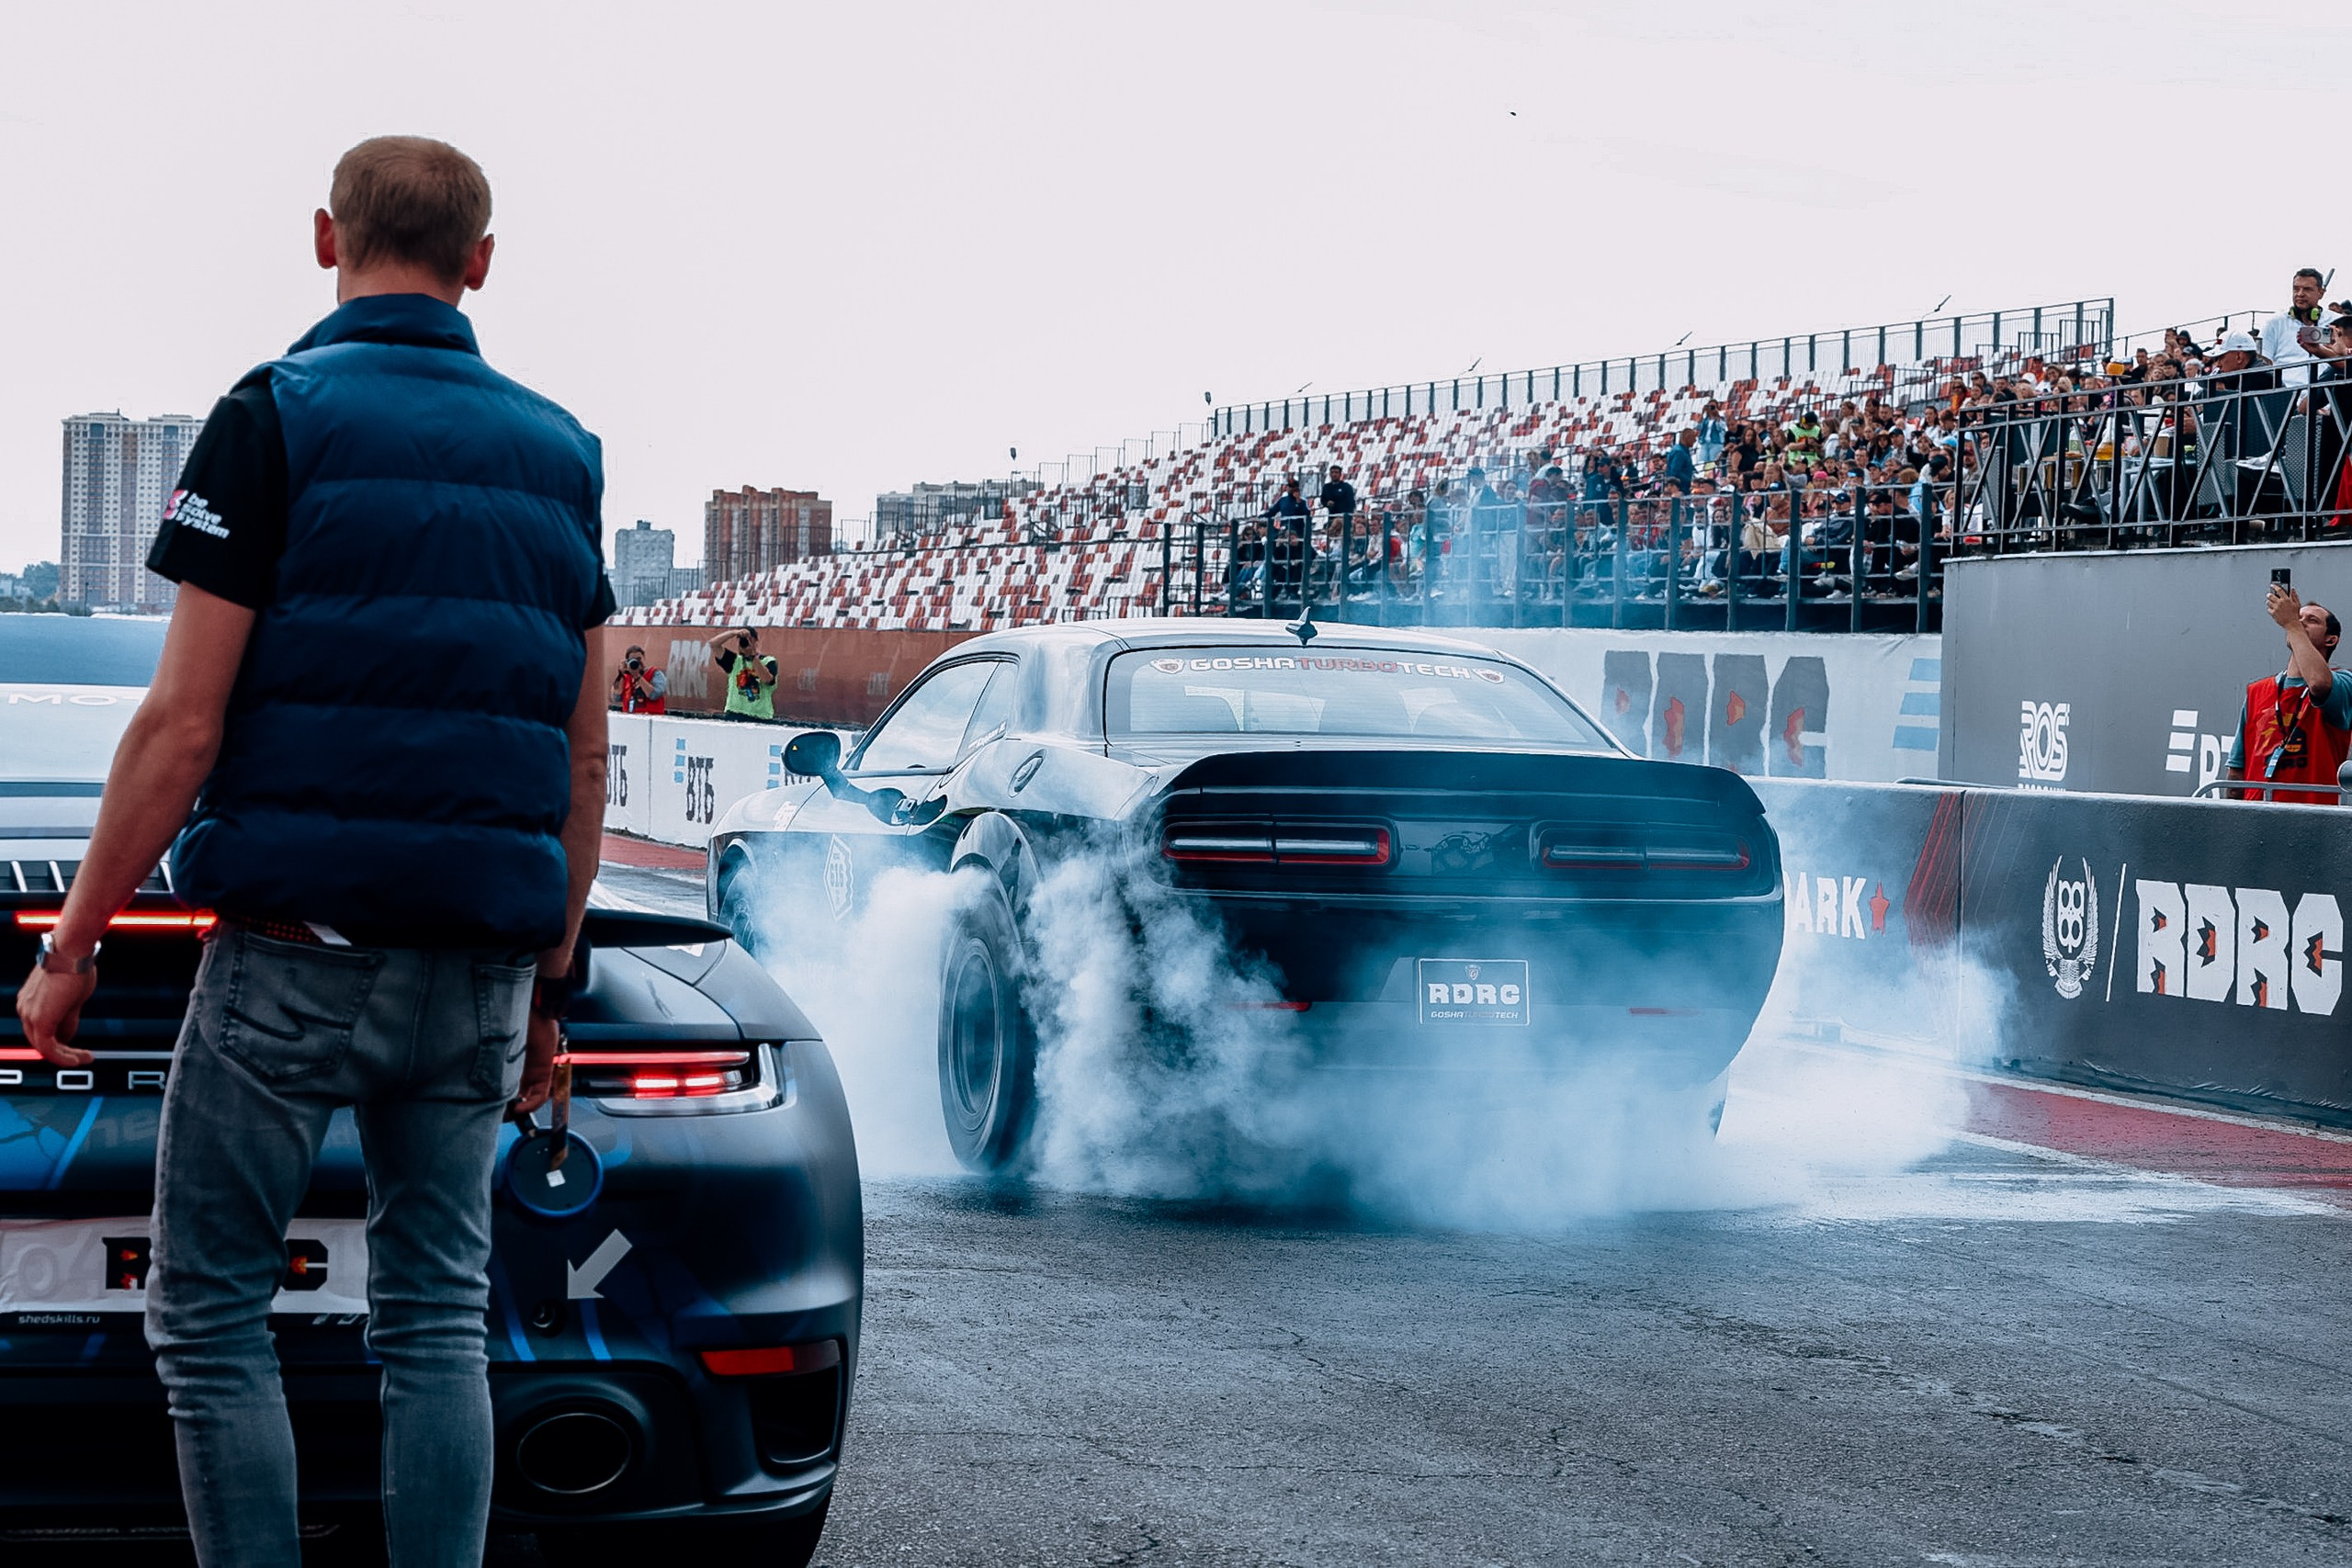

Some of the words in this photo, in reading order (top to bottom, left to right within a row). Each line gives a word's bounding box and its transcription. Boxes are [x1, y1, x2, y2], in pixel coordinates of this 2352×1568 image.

[175, 513, 230, 538] system
[1783, 870, 1867, 940] ARK
[2135, 878, 2344, 1016] RDRC
[1428, 983, 1521, 1005] RDRC
